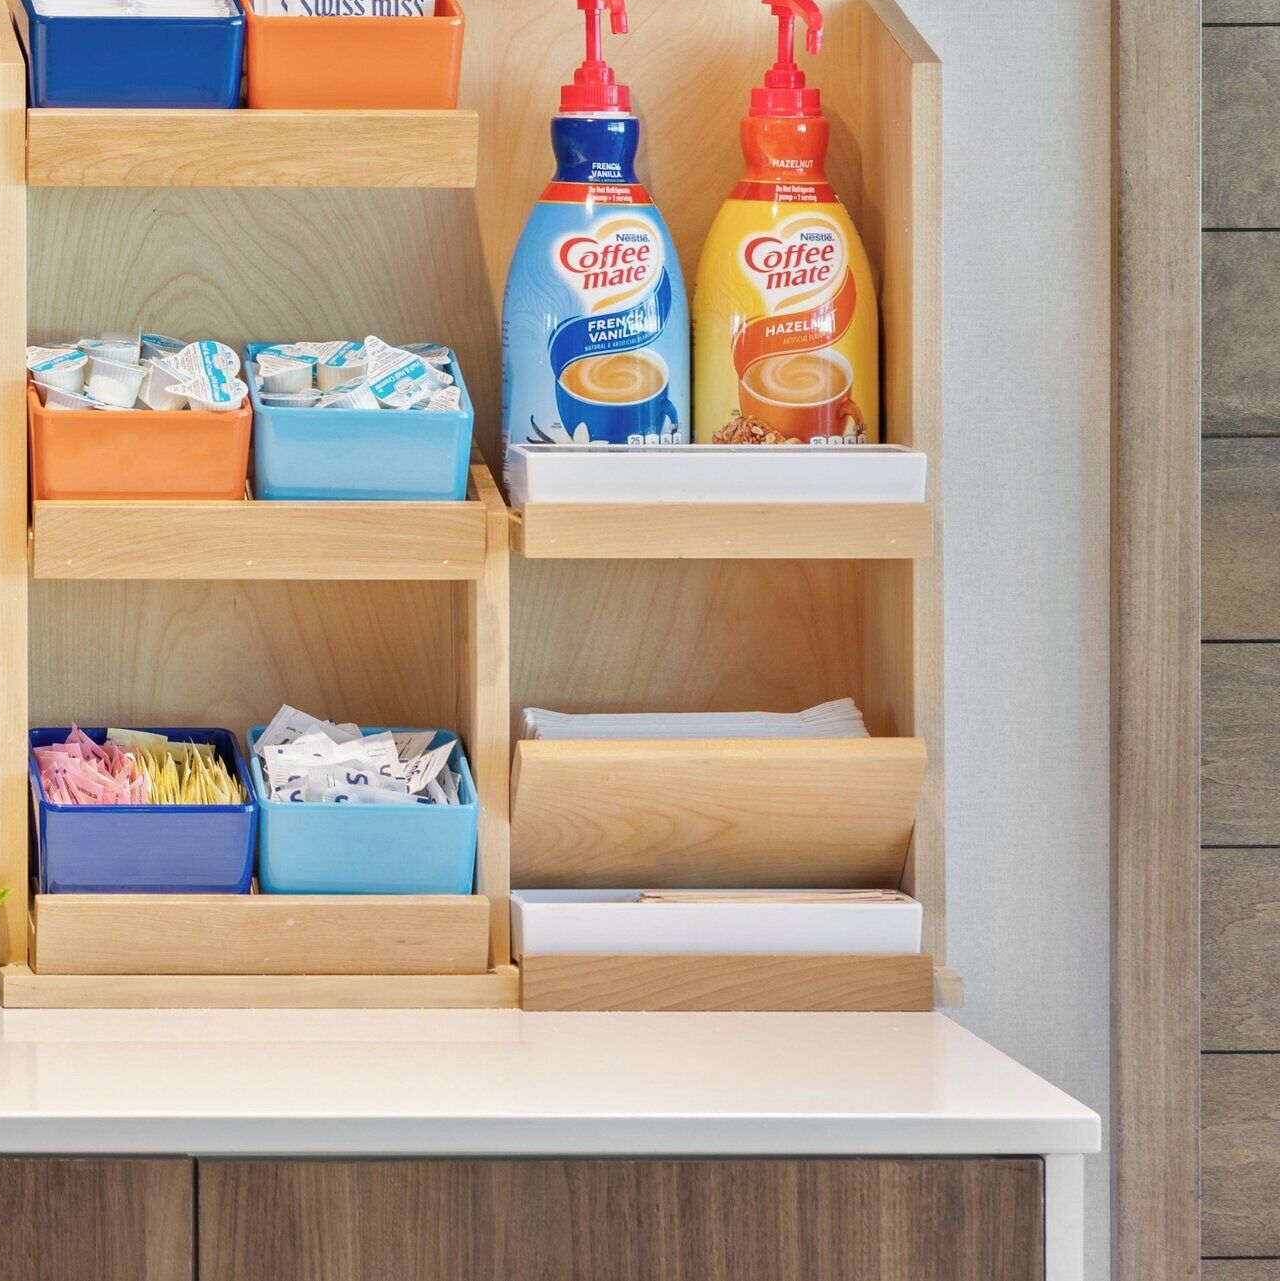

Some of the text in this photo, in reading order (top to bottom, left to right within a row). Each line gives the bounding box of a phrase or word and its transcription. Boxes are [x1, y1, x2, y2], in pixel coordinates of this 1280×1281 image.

[592, 162, 621, 171] FRENCH
[772, 160, 814, 168] HAZELNUT
[591, 170, 622, 178] VANILLA
[792, 185, 815, 194] Refrigerate
[801, 194, 817, 202] serving
[560, 237, 650, 273] Coffee
[744, 237, 834, 273] Coffee
[583, 265, 646, 289] mate
[766, 265, 830, 289] mate
[765, 309, 837, 337] HAZELNT
